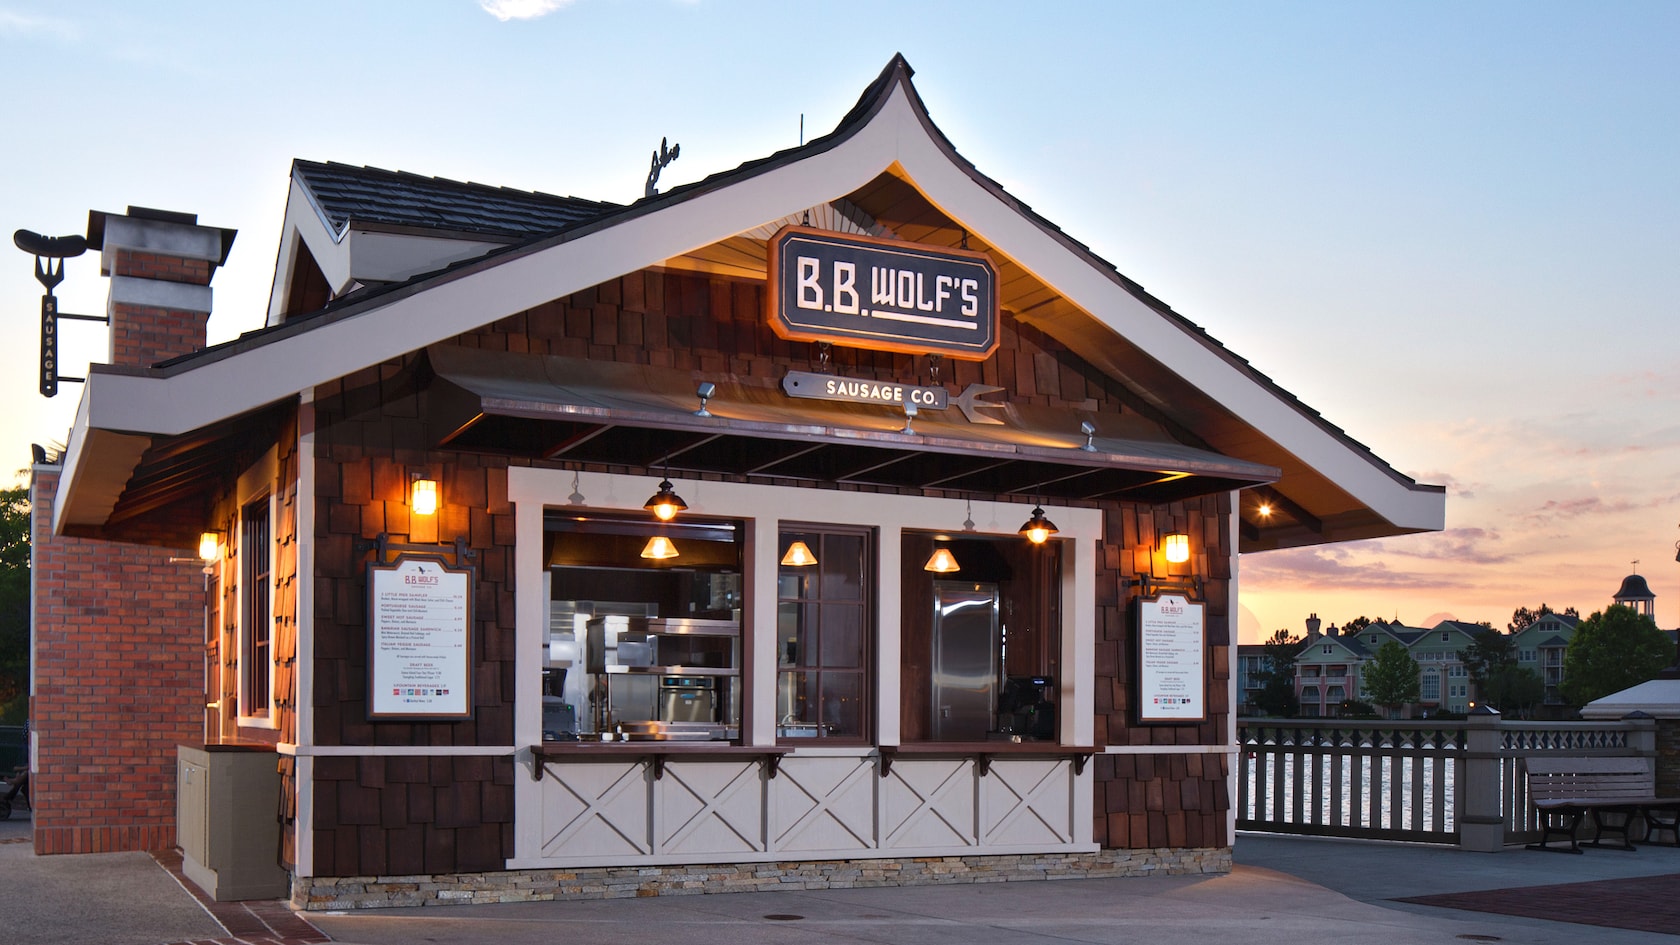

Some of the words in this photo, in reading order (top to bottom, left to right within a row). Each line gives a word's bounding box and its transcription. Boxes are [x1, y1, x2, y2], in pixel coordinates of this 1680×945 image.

[797, 256, 869, 317] B.B.
[871, 266, 978, 317] WOLF'S
[44, 303, 54, 380] SAUSAGE
[826, 380, 902, 401] SAUSAGE
[911, 389, 939, 405] CO.
